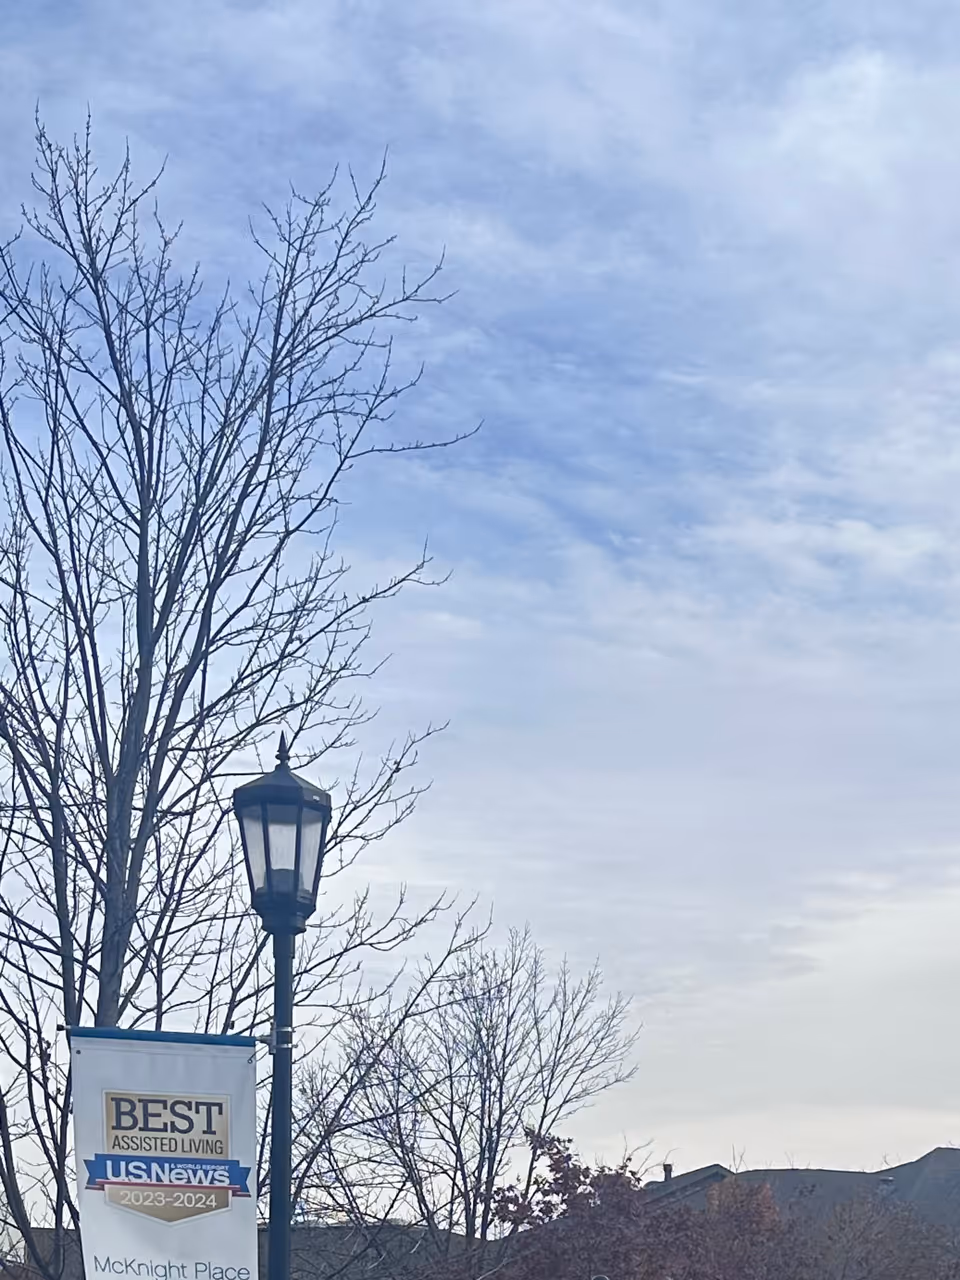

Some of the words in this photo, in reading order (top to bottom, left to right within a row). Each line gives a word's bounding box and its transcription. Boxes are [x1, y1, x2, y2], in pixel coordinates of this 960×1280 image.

[110, 1097, 223, 1135] BEST
[112, 1135, 178, 1153] ASSISTED
[181, 1138, 224, 1155] LIVING
[120, 1190, 217, 1208] 2023-2024
[194, 1261, 251, 1280] Place
